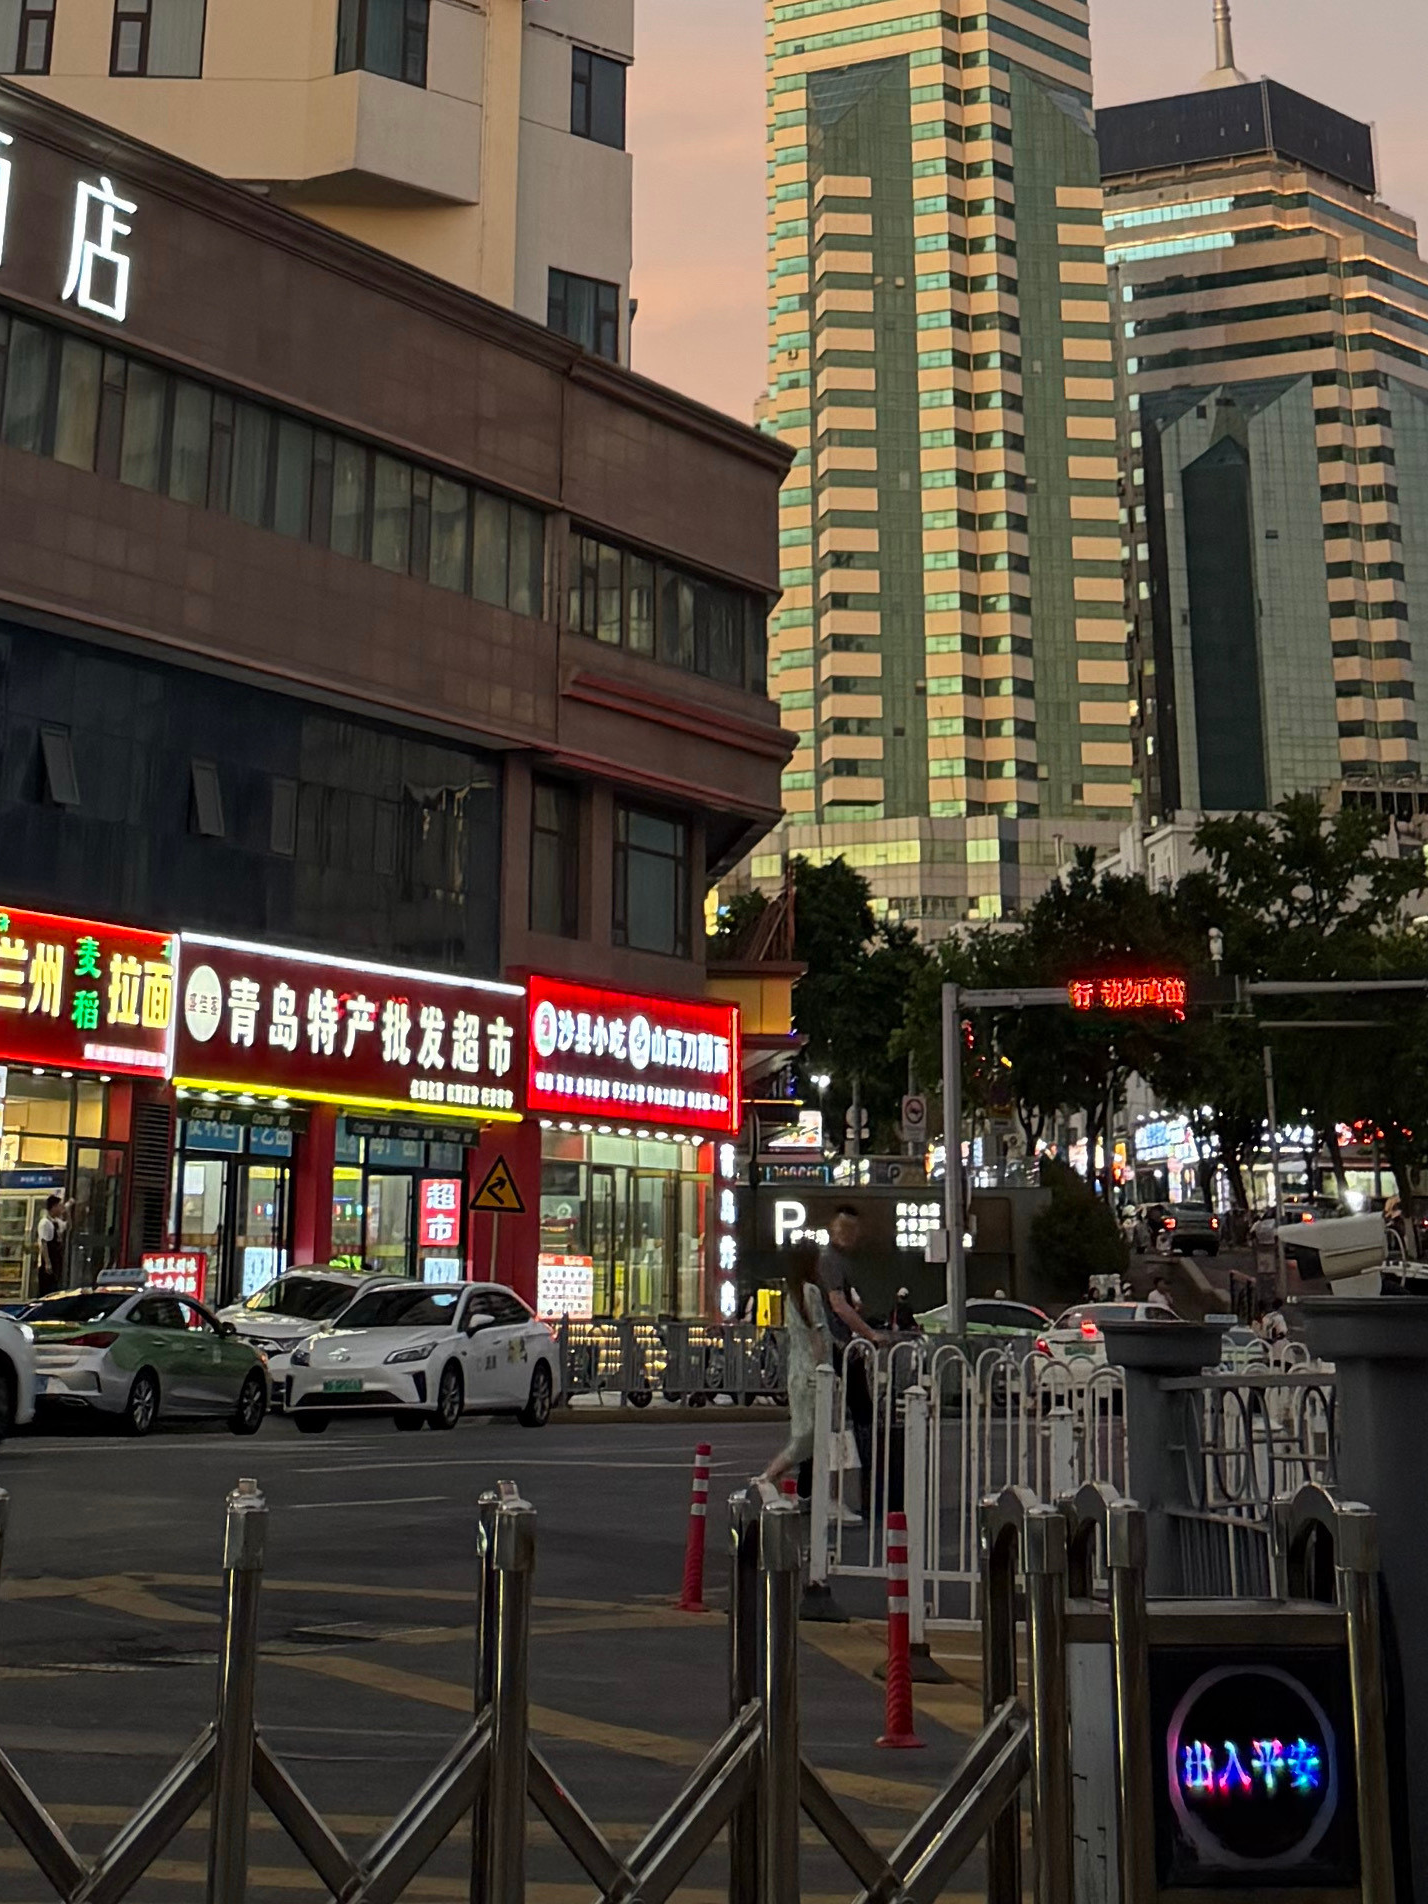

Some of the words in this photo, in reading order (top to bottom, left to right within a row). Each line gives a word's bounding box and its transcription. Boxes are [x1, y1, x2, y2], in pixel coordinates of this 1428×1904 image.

[72, 936, 101, 1030] 麦稻
[107, 953, 174, 1029] 拉面
[227, 976, 515, 1078] 青岛特产批发超市
[557, 1009, 628, 1060] 沙县小吃
[651, 1024, 729, 1074] 山西刀削面
[426, 1183, 456, 1241] 超市
[775, 1201, 806, 1245] P
[1185, 1738, 1320, 1790] 出入平安
